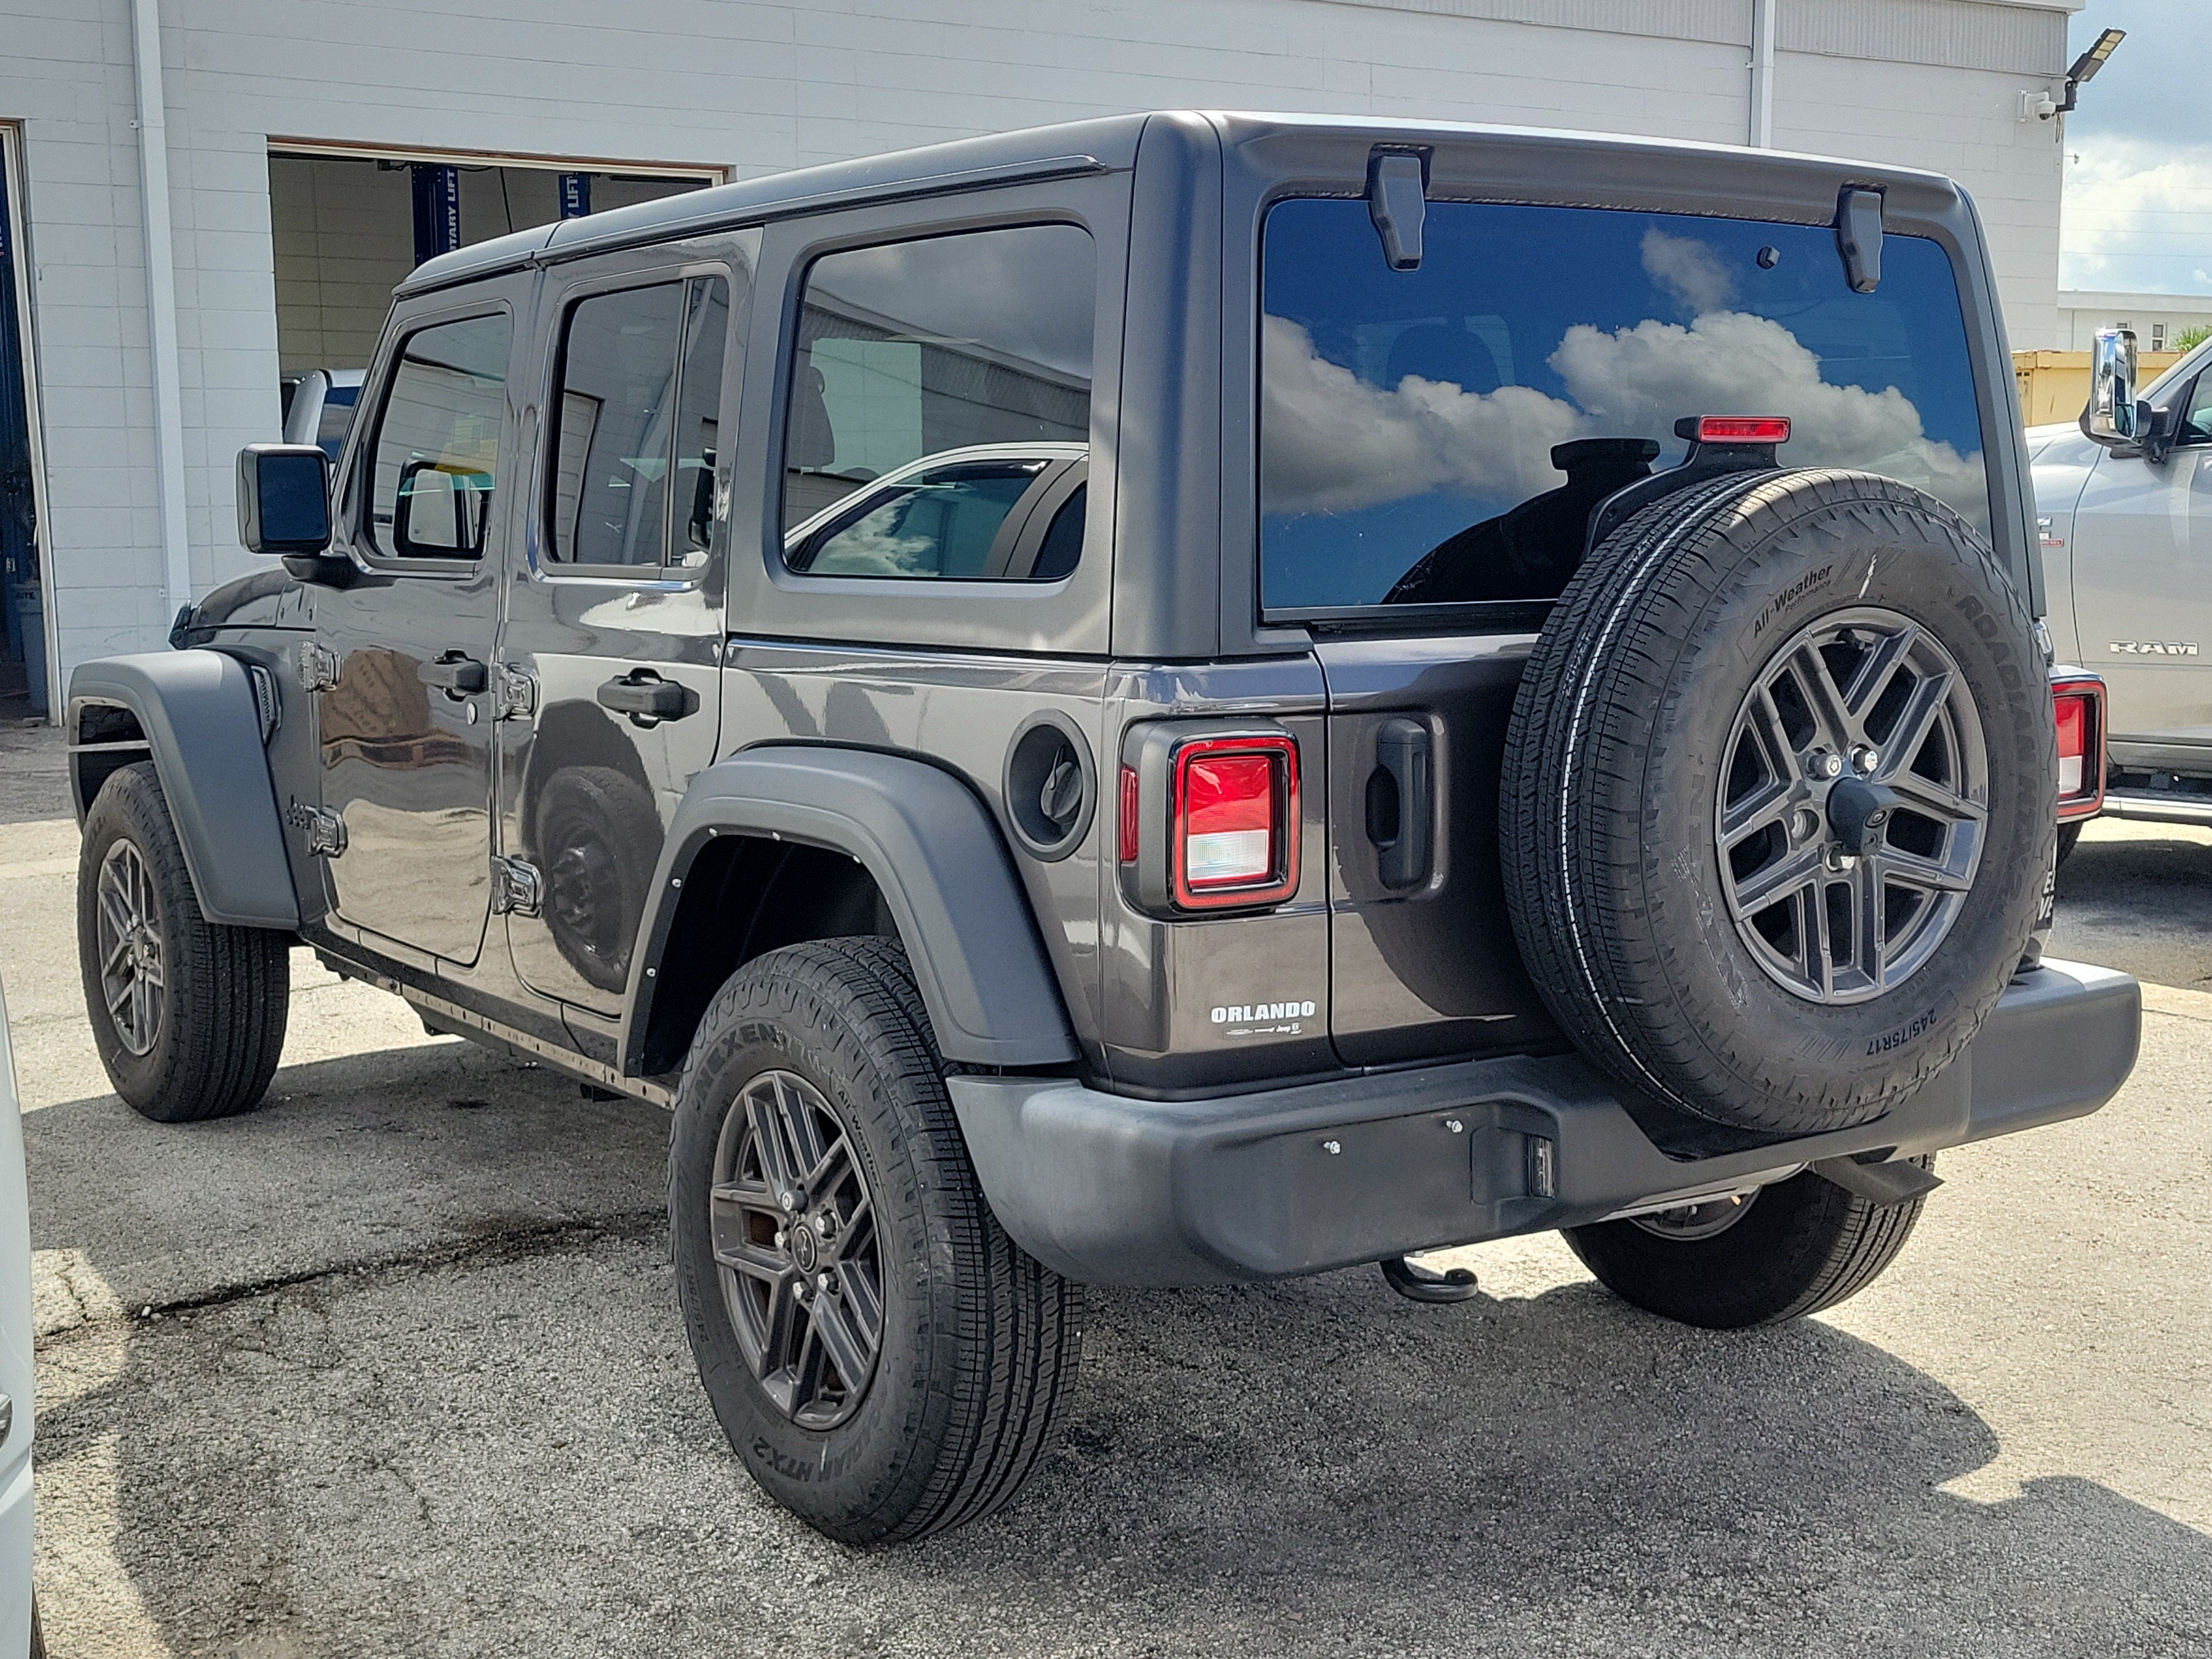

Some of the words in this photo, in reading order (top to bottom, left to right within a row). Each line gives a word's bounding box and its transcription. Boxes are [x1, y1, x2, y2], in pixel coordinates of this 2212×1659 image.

[447, 168, 456, 201] LIFT
[566, 176, 579, 208] LIFT
[1754, 564, 1833, 639] All-Weather
[2109, 640, 2198, 656] RAM
[1211, 1001, 1316, 1023] ORLANDO
[1866, 1008, 1937, 1056] 245/75R17
[753, 1436, 814, 1482] HTX2
